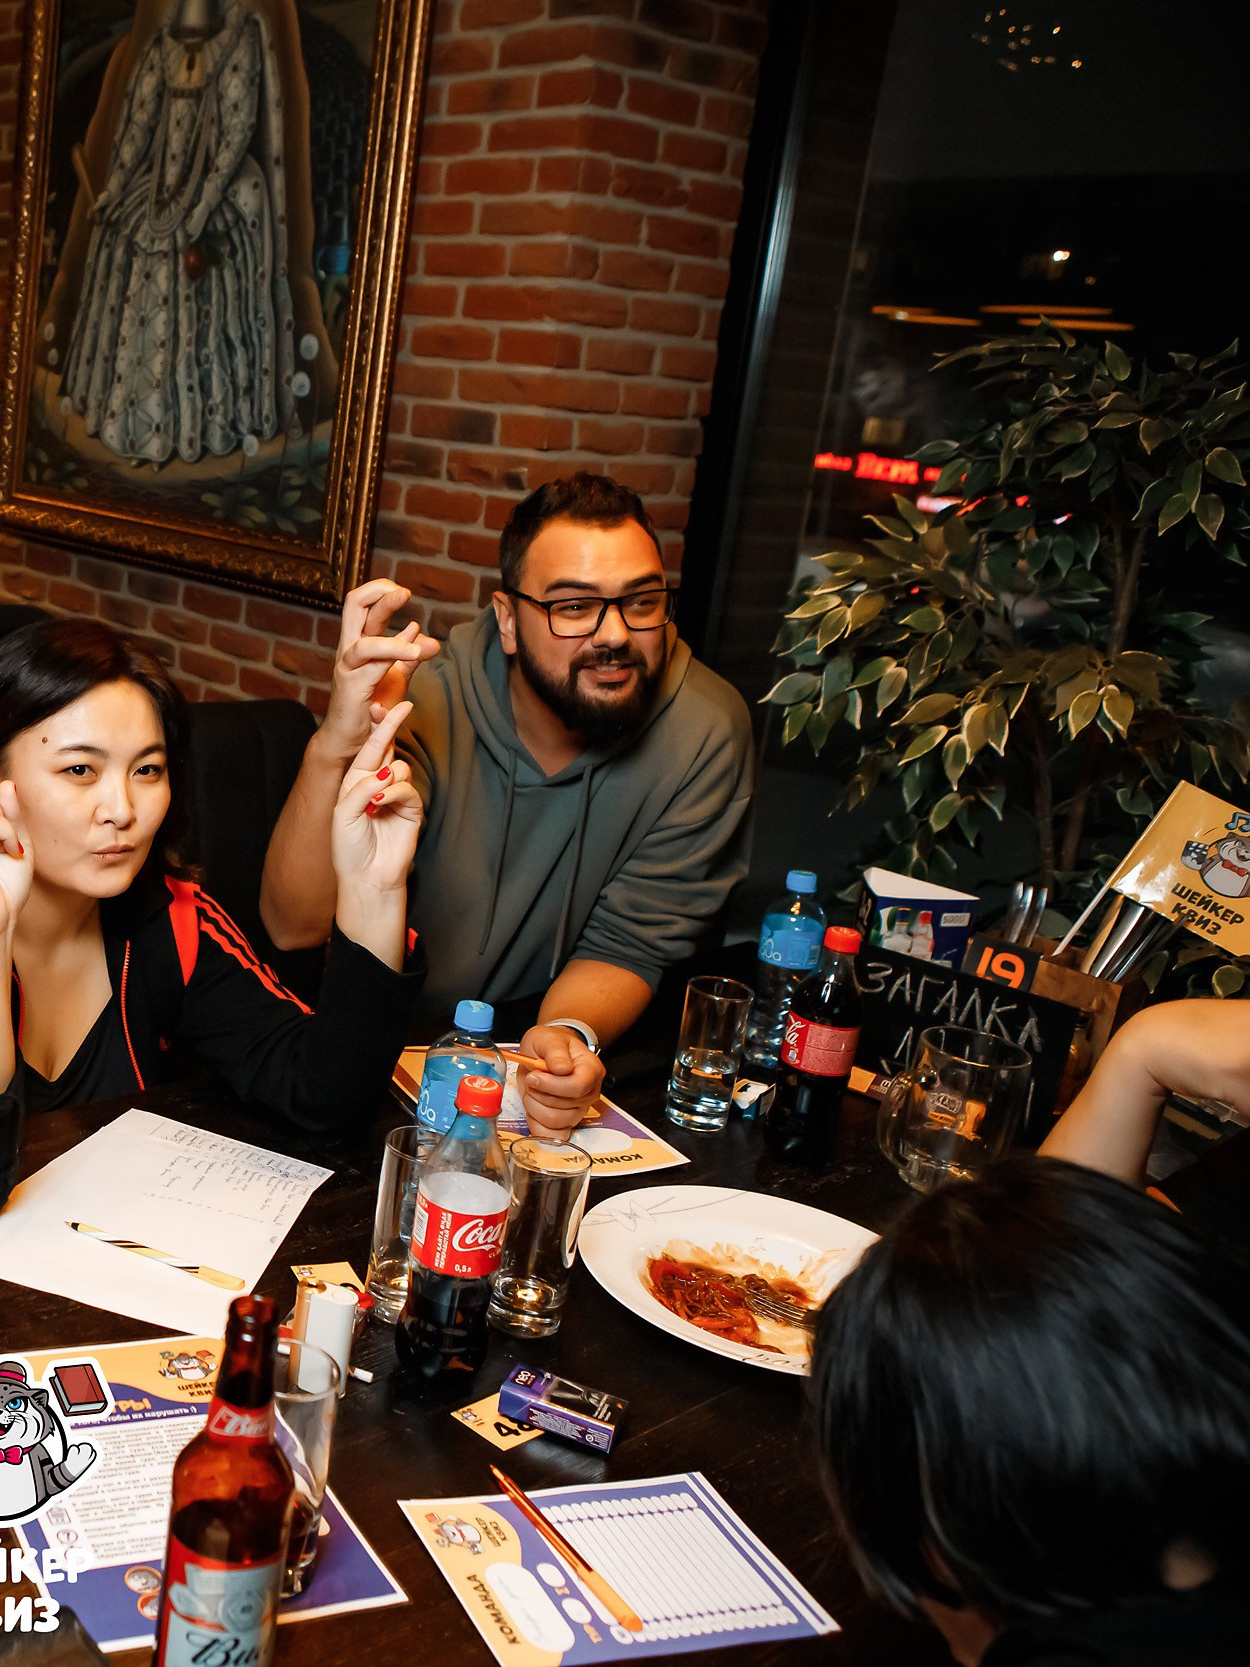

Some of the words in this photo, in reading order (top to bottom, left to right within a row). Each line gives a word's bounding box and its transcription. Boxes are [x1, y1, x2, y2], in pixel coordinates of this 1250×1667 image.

[1171, 882, 1245, 925] ШЕЙКЕР
[1171, 902, 1222, 935] КВИЗ
[177, 1381, 215, 1391] ШЕЙКЕ
[188, 1389, 214, 1397] КВИ
